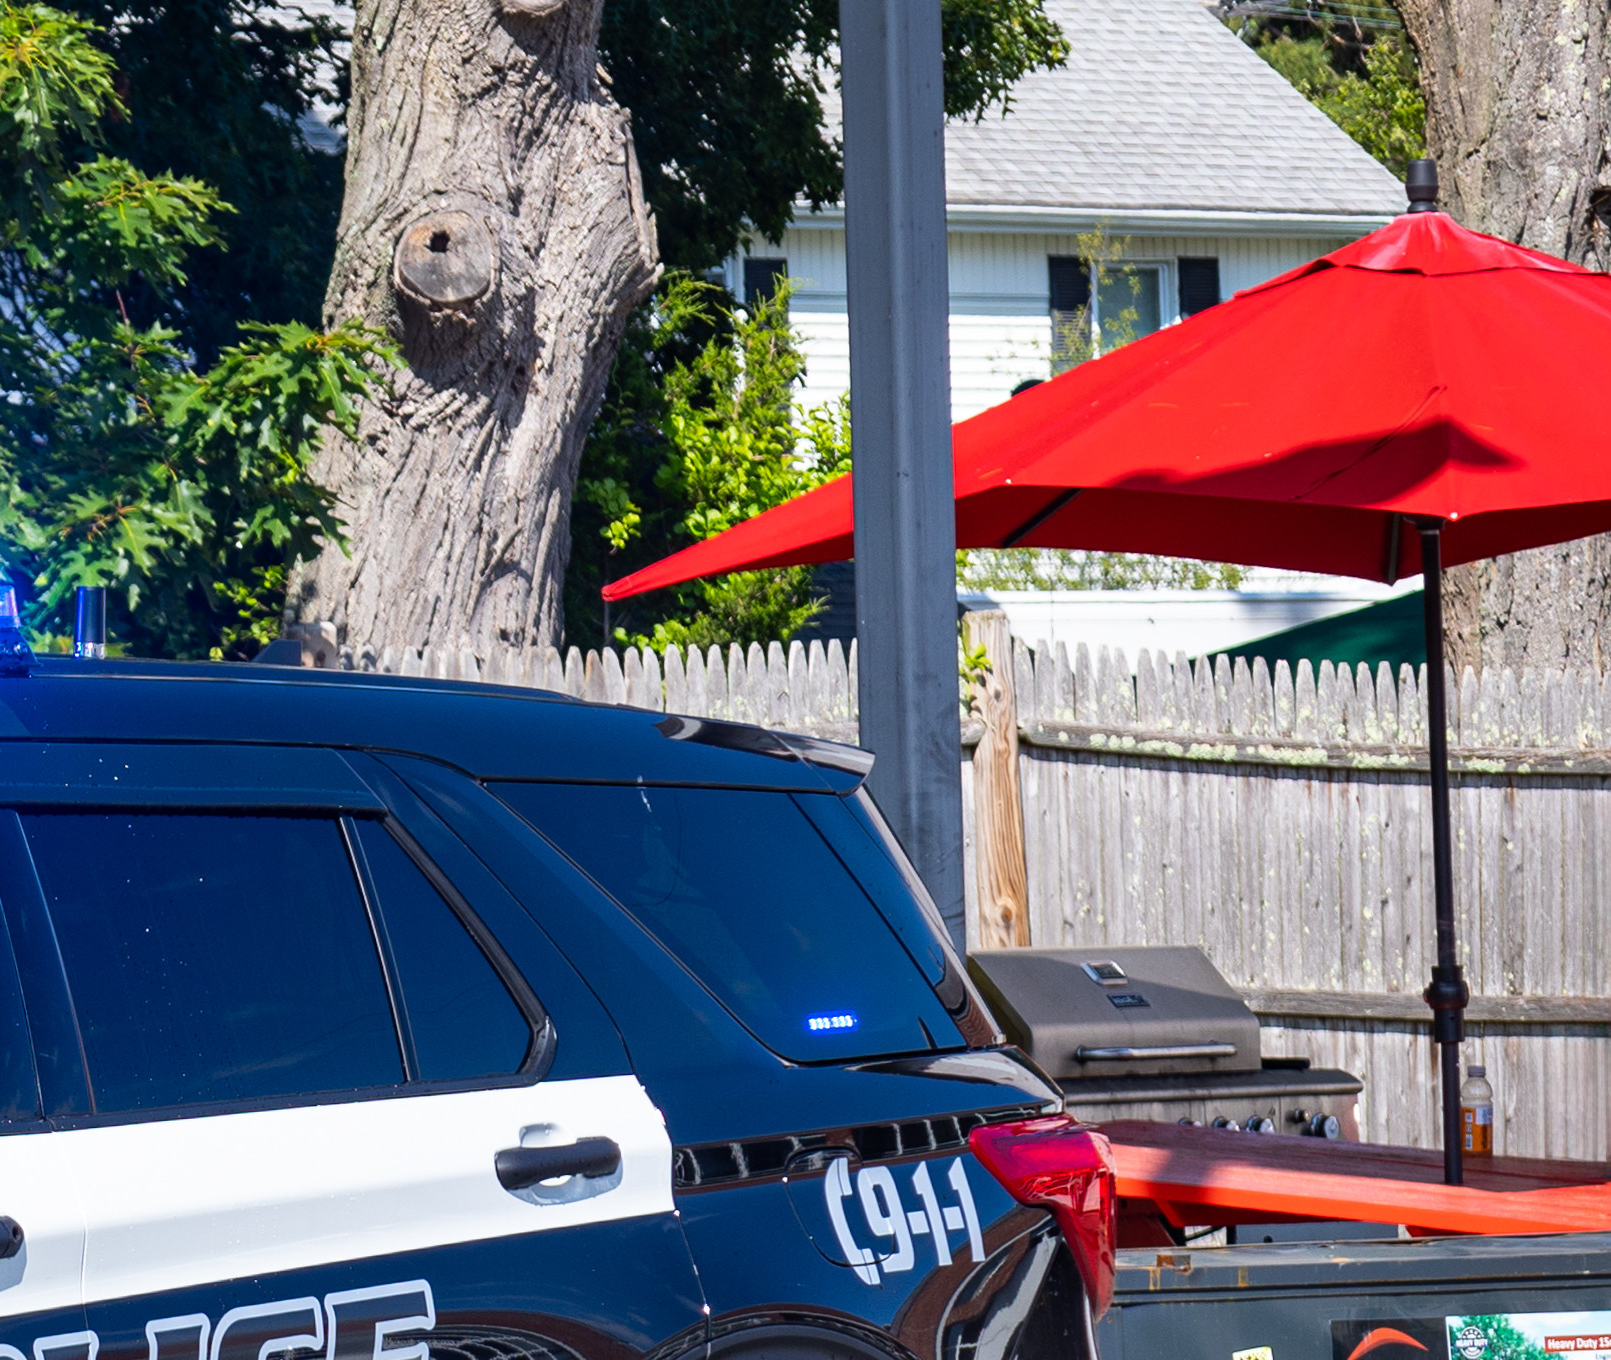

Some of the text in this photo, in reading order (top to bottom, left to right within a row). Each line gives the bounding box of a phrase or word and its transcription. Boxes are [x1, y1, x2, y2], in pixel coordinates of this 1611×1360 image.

[857, 1156, 986, 1273] 9-1-1
[1547, 1338, 1575, 1350] Heavy
[1576, 1337, 1598, 1349] Duty
